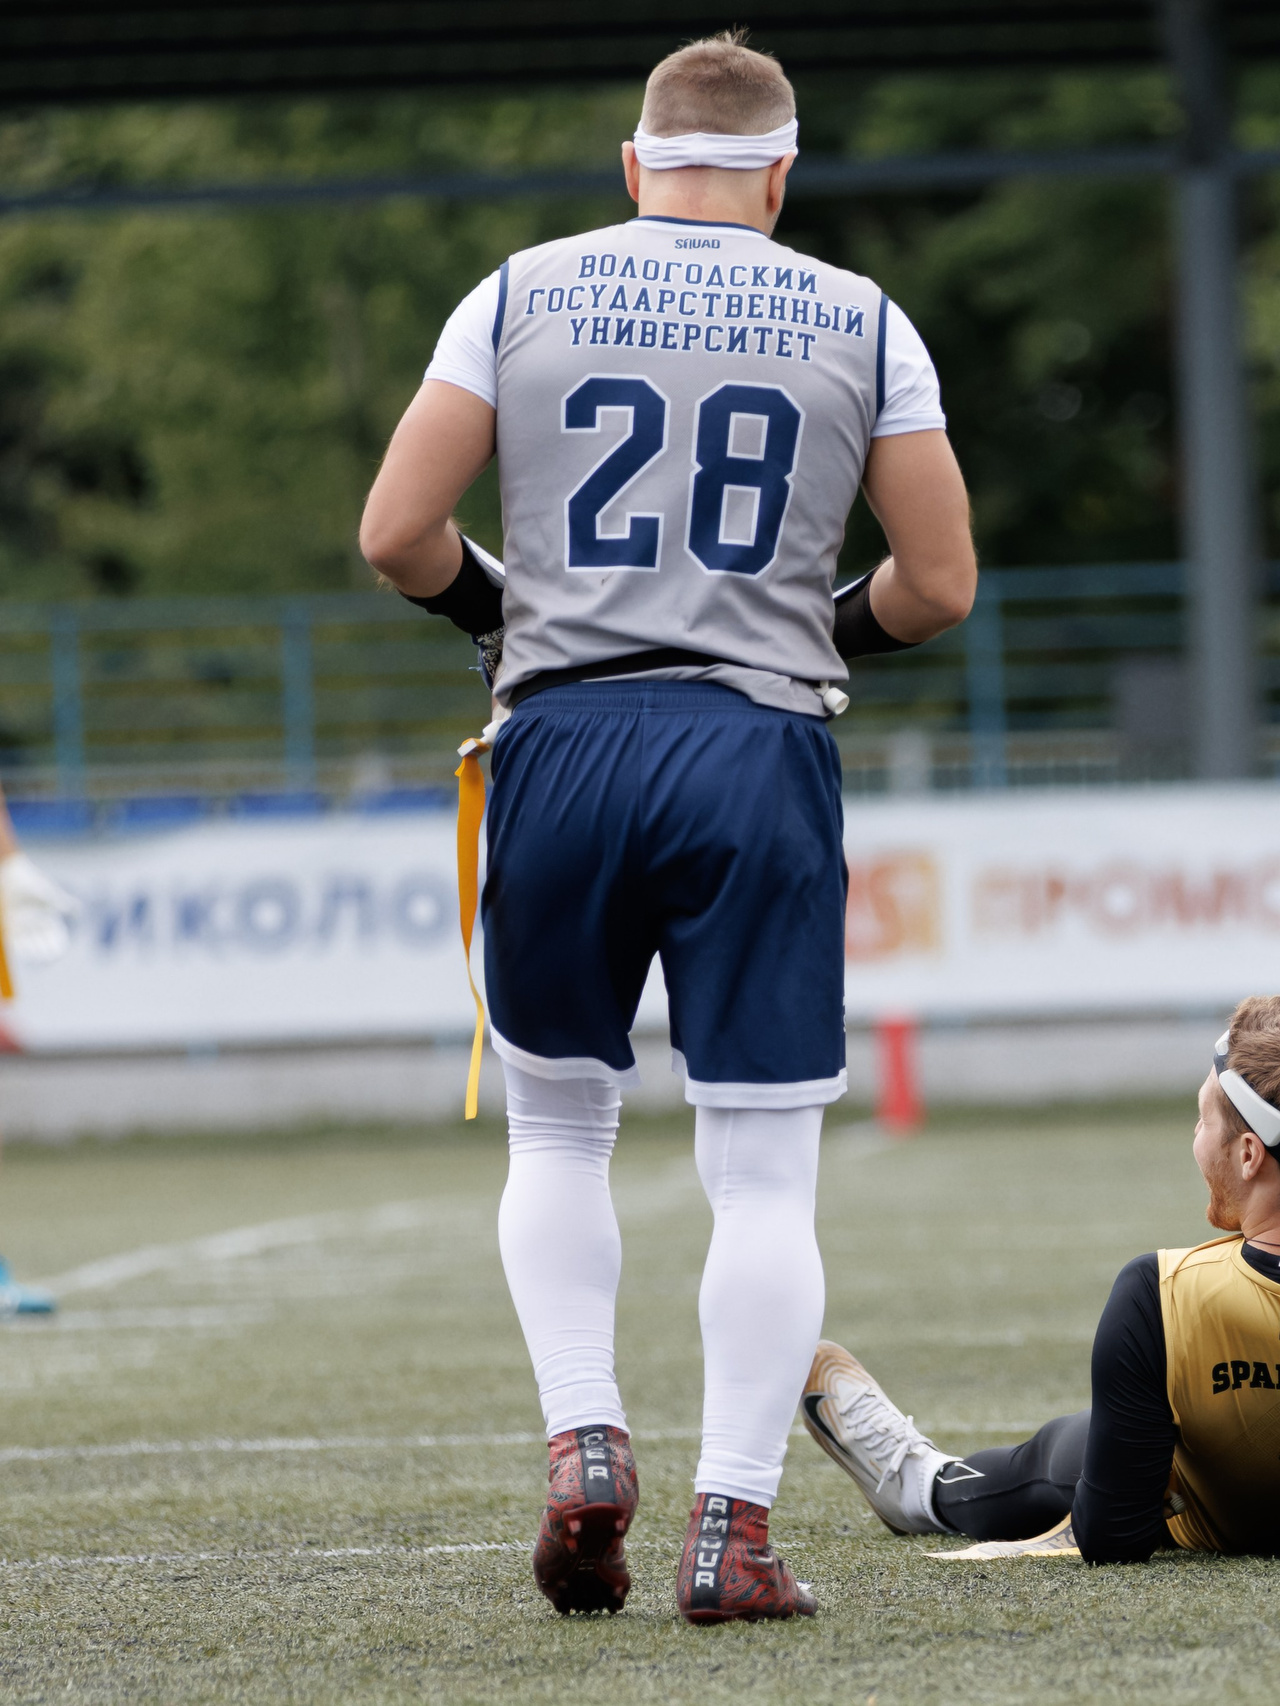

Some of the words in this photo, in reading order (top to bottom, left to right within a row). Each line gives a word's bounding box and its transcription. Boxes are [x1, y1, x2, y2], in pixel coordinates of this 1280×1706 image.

[577, 252, 818, 296] ВОЛОГОДСКИЙ
[525, 282, 866, 338] ГОСУДАРСТВЕННЫЙ
[569, 316, 817, 362] УНИВЕРСИТЕТ
[561, 372, 806, 580] 28
